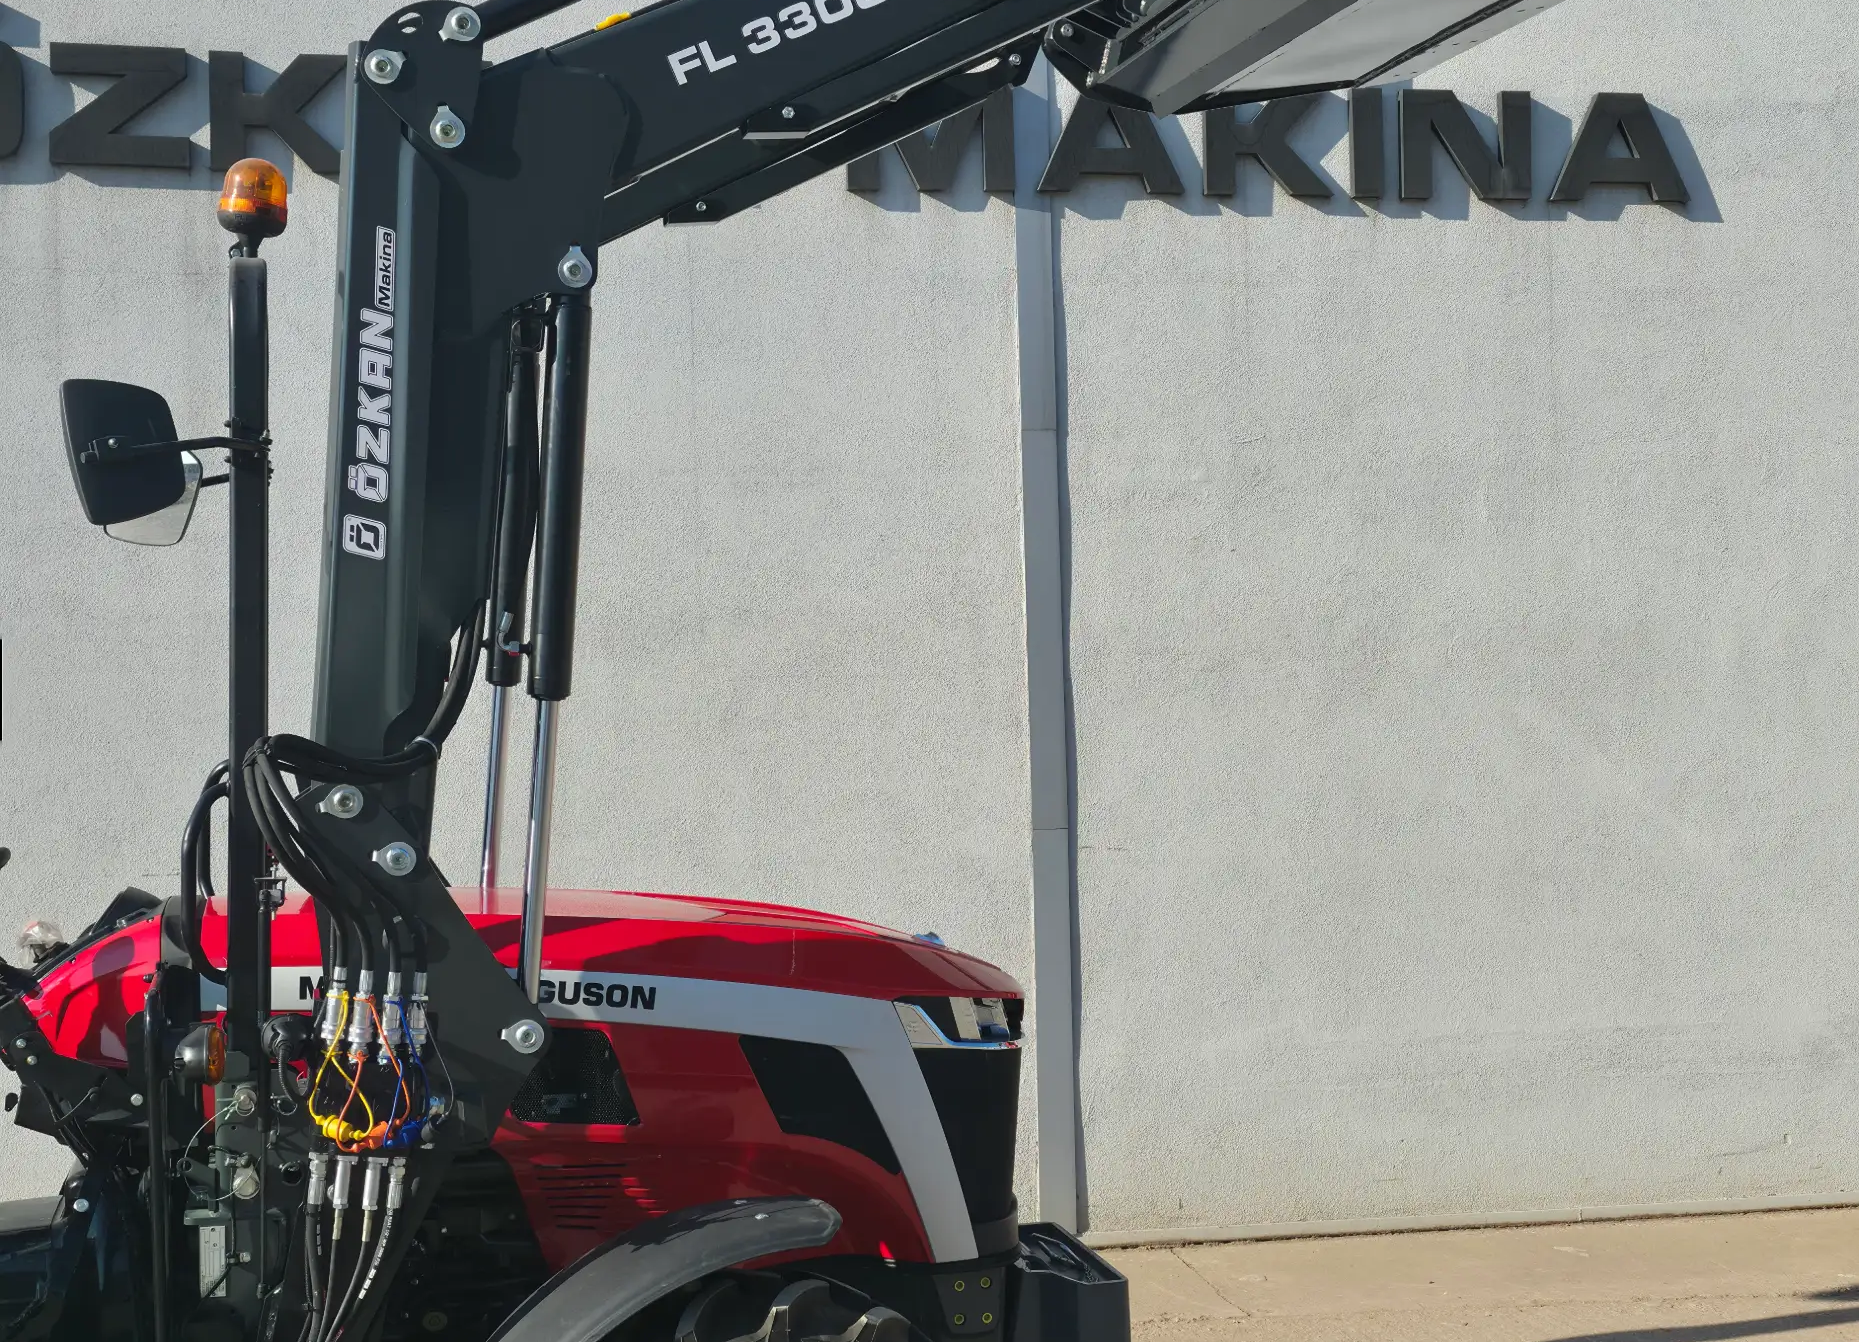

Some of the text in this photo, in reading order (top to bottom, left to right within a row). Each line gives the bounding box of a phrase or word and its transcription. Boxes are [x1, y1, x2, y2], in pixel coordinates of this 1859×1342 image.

[667, 40, 737, 85] FL
[348, 308, 393, 503] ÖZKAN
[378, 231, 393, 308] Makina
[538, 979, 657, 1010] GUSON
